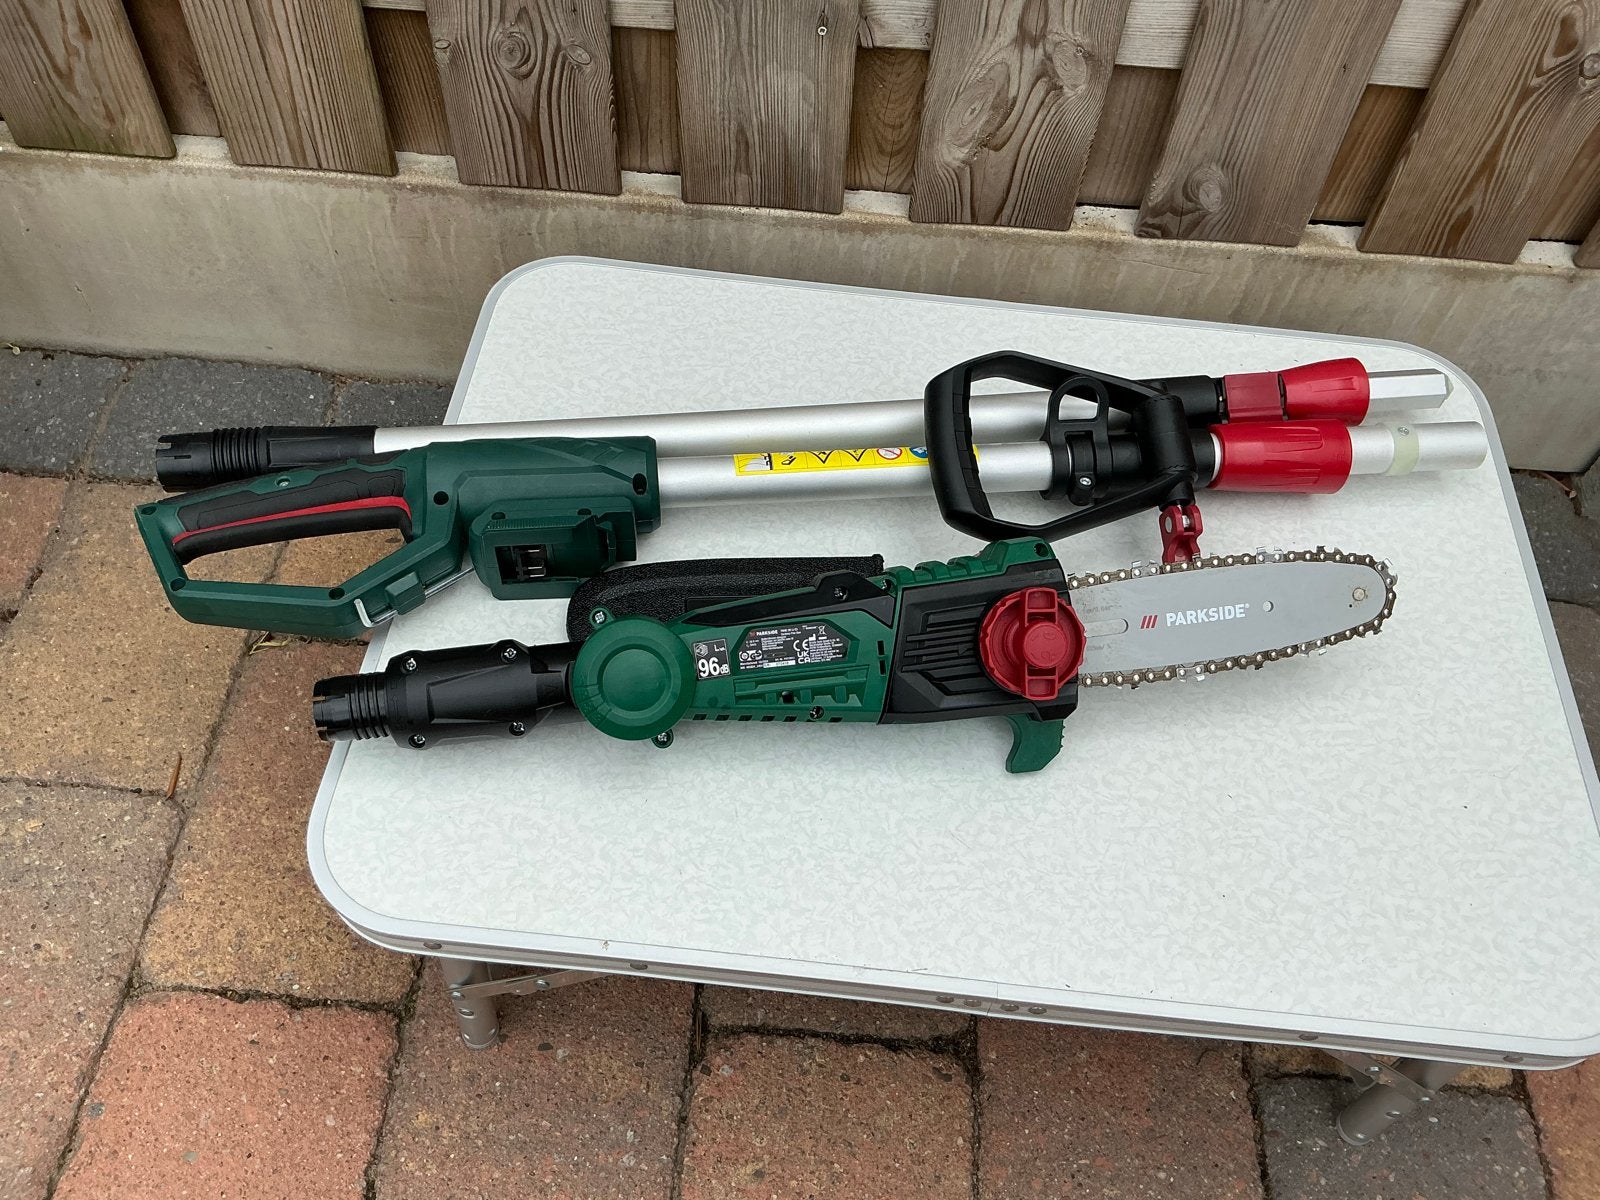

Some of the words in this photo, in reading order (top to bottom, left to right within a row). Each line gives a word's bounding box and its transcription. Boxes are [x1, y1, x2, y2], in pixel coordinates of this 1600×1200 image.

[1165, 603, 1247, 627] PARKSIDE
[698, 656, 720, 677] 96
[720, 663, 729, 674] dB
